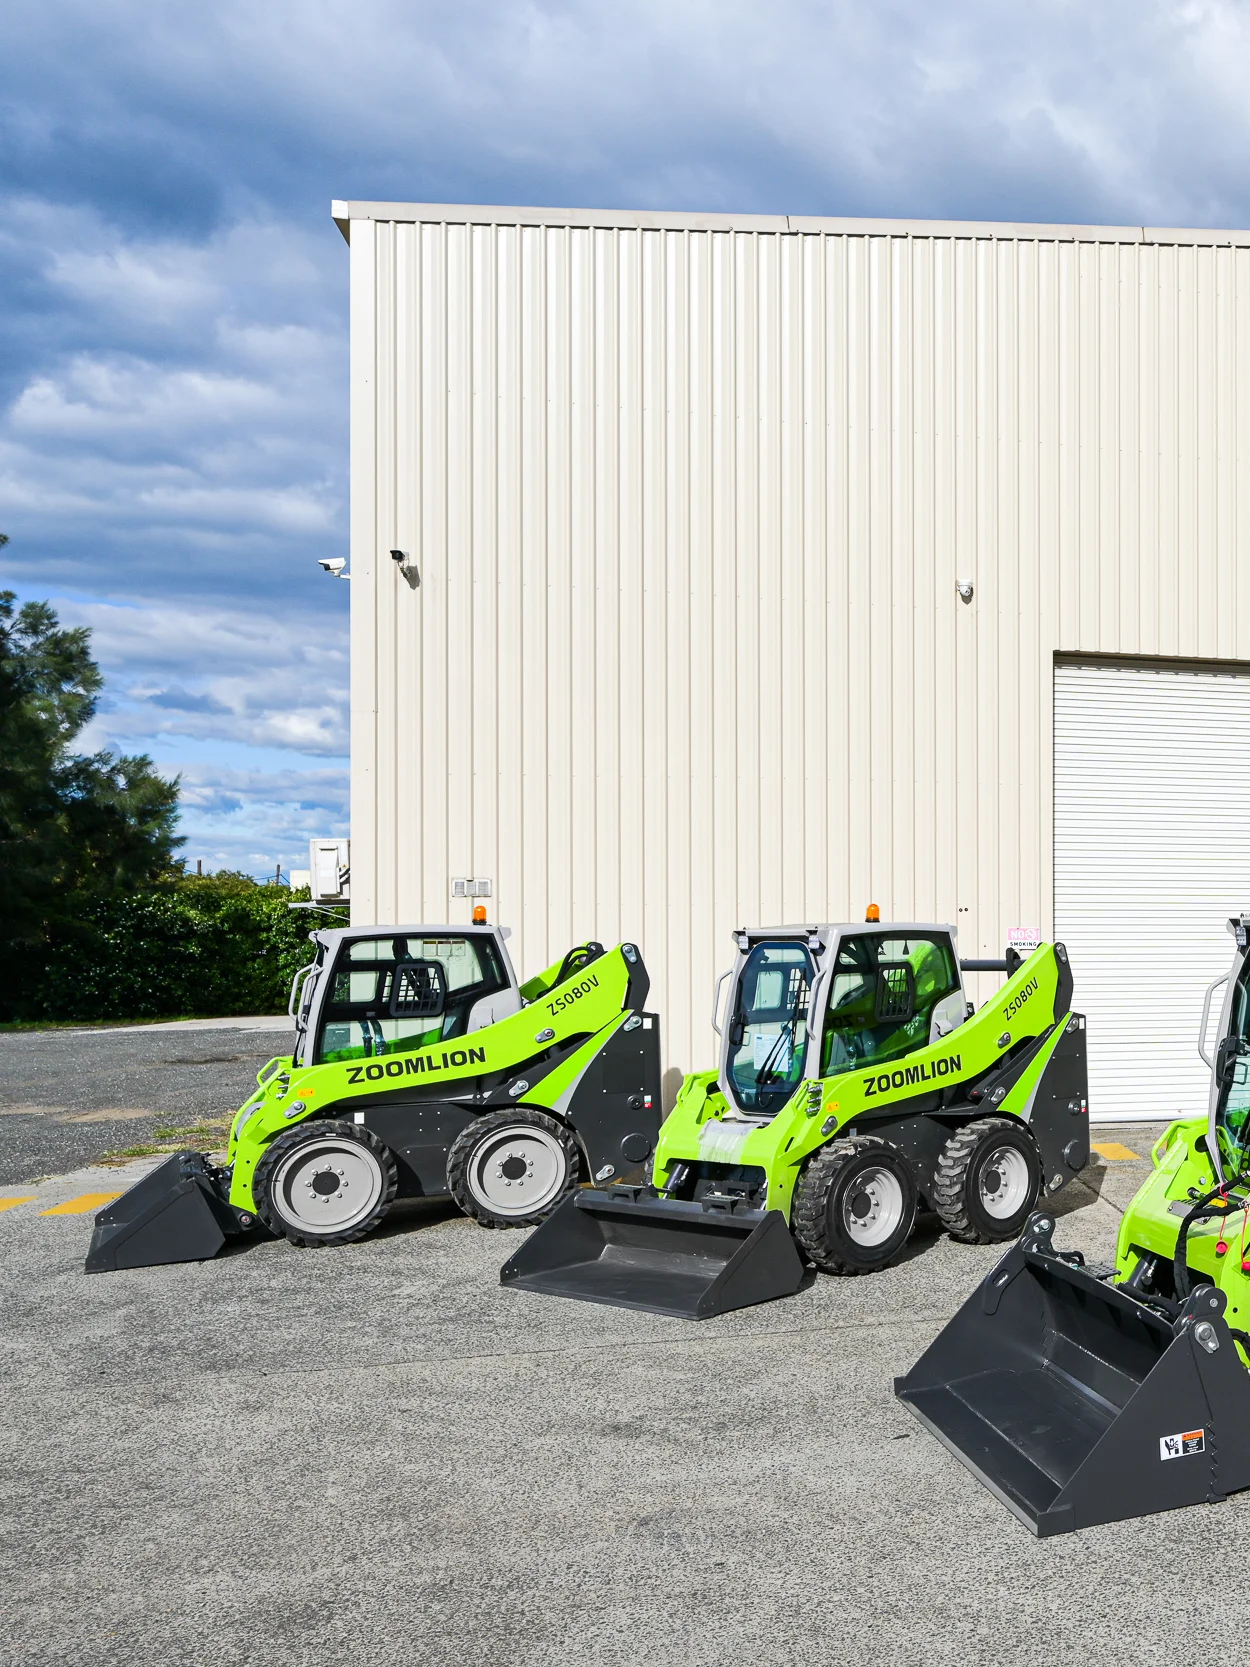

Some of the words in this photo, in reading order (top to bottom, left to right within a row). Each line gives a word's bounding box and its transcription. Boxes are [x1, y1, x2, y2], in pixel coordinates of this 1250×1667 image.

[1011, 930, 1025, 939] NO
[546, 974, 599, 1017] ZS080V
[1002, 976, 1039, 1021] ZS080V
[346, 1046, 486, 1084] ZOOMLION
[863, 1054, 962, 1097] ZOOMLION
